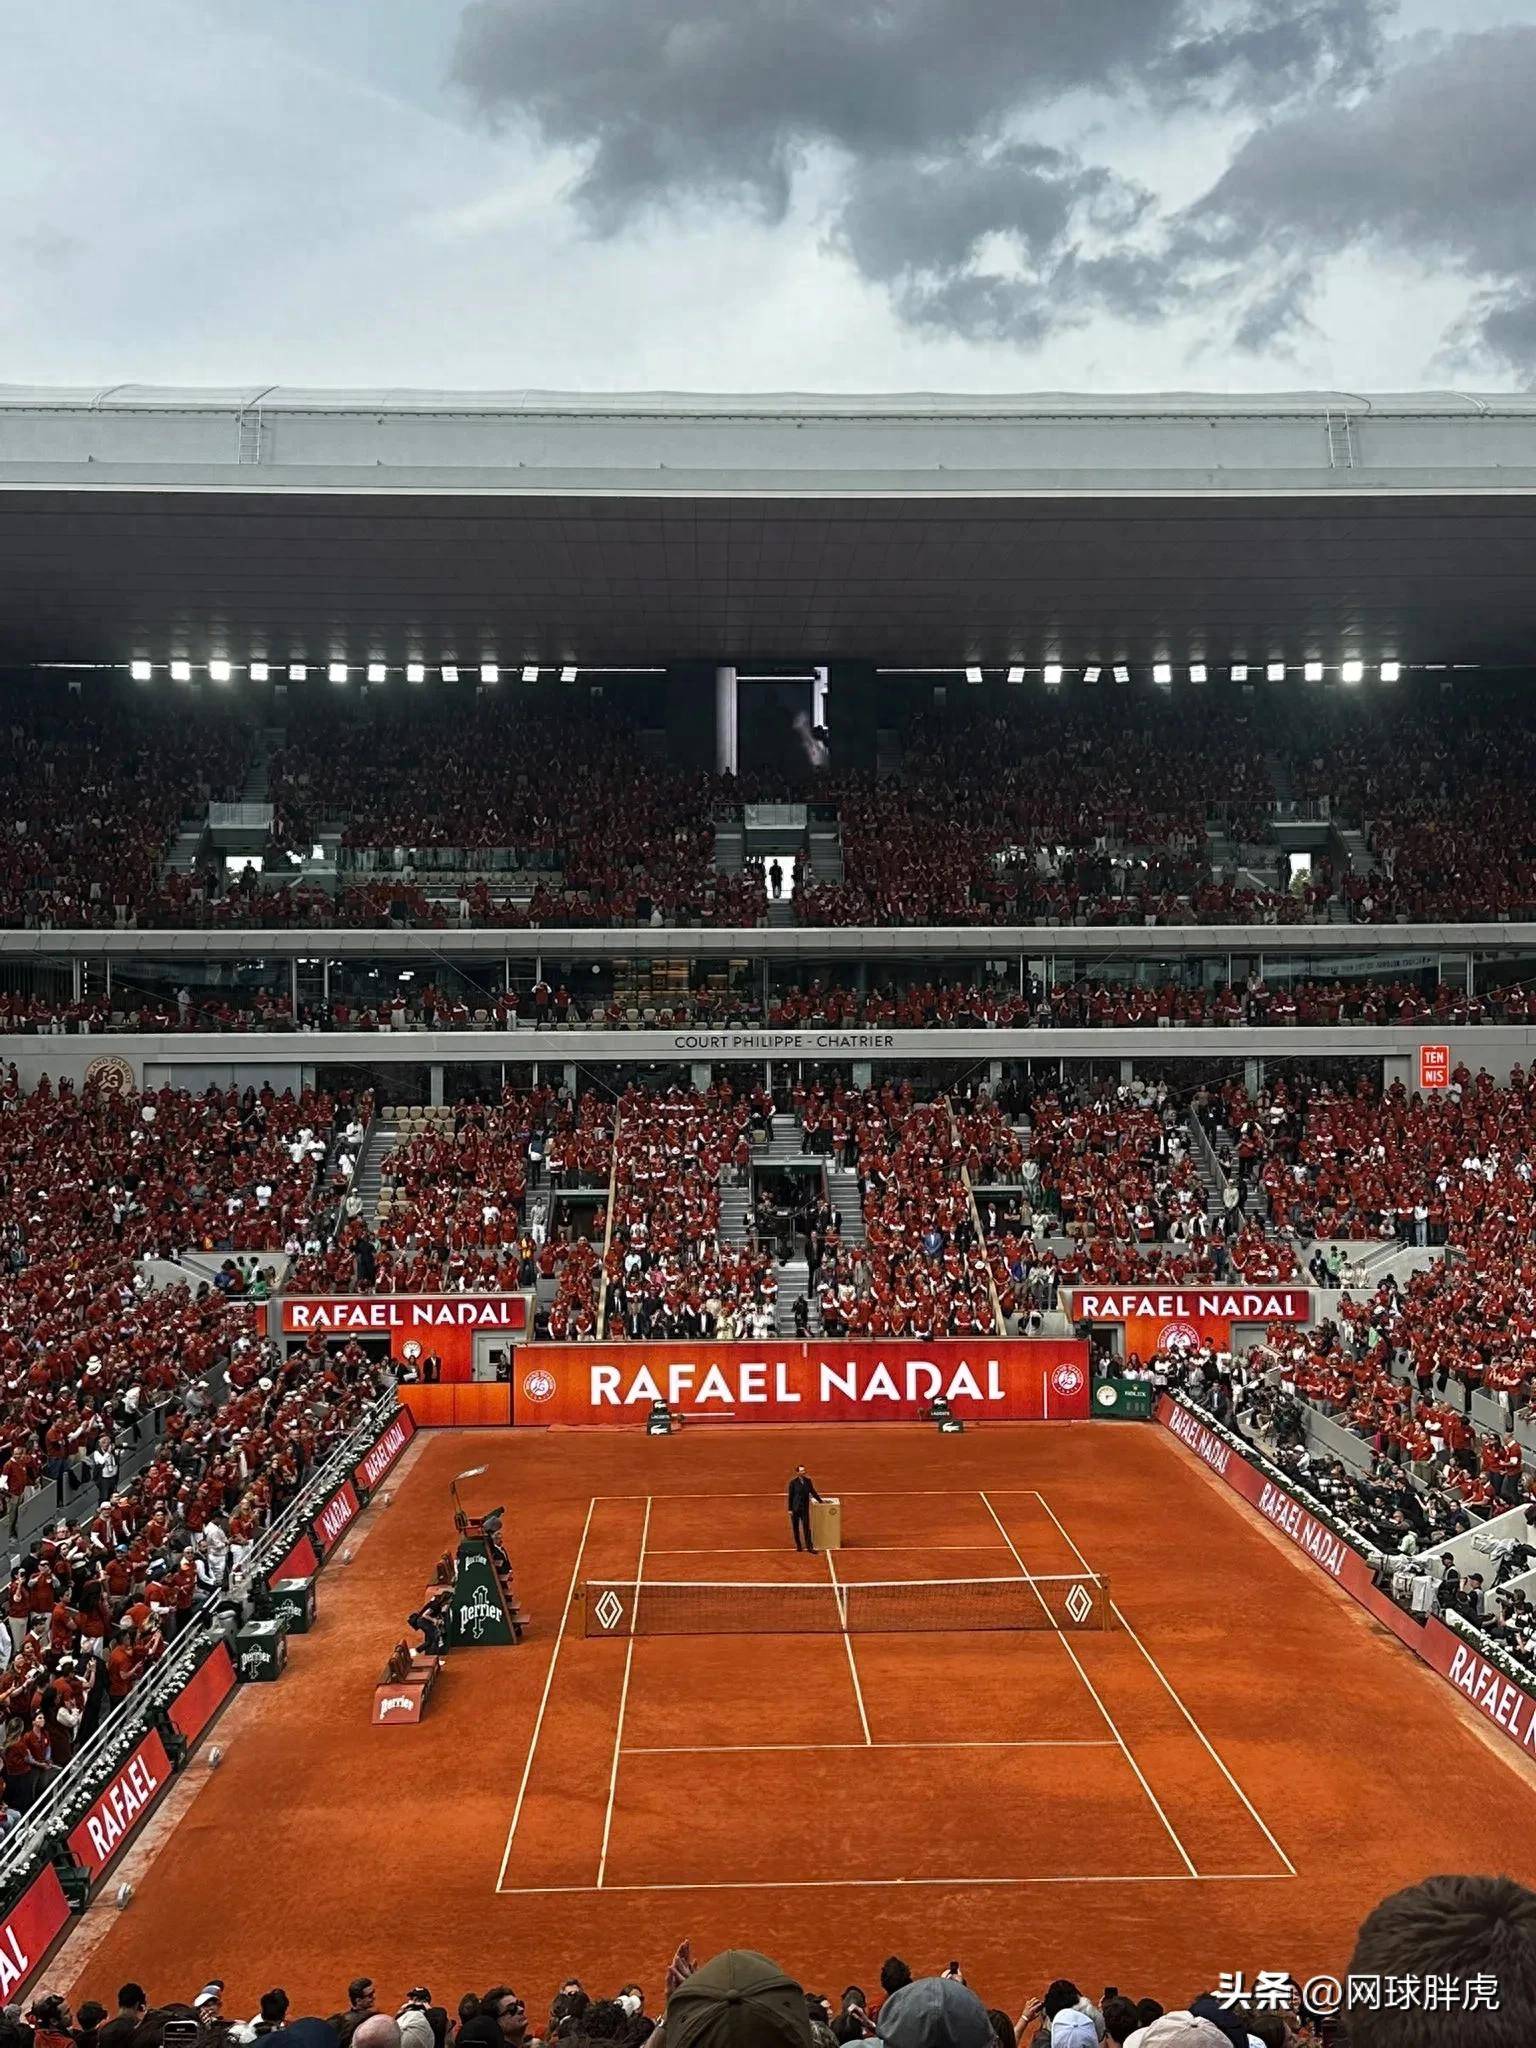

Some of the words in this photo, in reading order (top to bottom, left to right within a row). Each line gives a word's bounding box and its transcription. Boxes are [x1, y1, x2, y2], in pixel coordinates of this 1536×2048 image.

[674, 1036, 728, 1049] COURT
[733, 1035, 802, 1048] PHILIPPE
[816, 1035, 894, 1047] CHATRIER
[1424, 1051, 1444, 1064] TEN
[1425, 1070, 1444, 1083] NIS
[292, 1304, 404, 1327] RAFAEL
[413, 1302, 511, 1326] NADAL
[1082, 1295, 1190, 1317] RAFAEL
[1199, 1294, 1296, 1316] NADAL
[590, 1362, 801, 1406] RAFAEL
[820, 1360, 1006, 1402] NADAL
[1168, 1405, 1201, 1448] RAFAEL
[1199, 1427, 1232, 1474] NADAL
[365, 1443, 390, 1484] RAFAEL
[322, 1492, 352, 1540] NADAL
[1258, 1482, 1304, 1538] RAFAEL
[1302, 1517, 1348, 1576] NADAL
[1448, 1644, 1524, 1736] RAFAEL
[86, 1754, 157, 1861] RAFAEL
